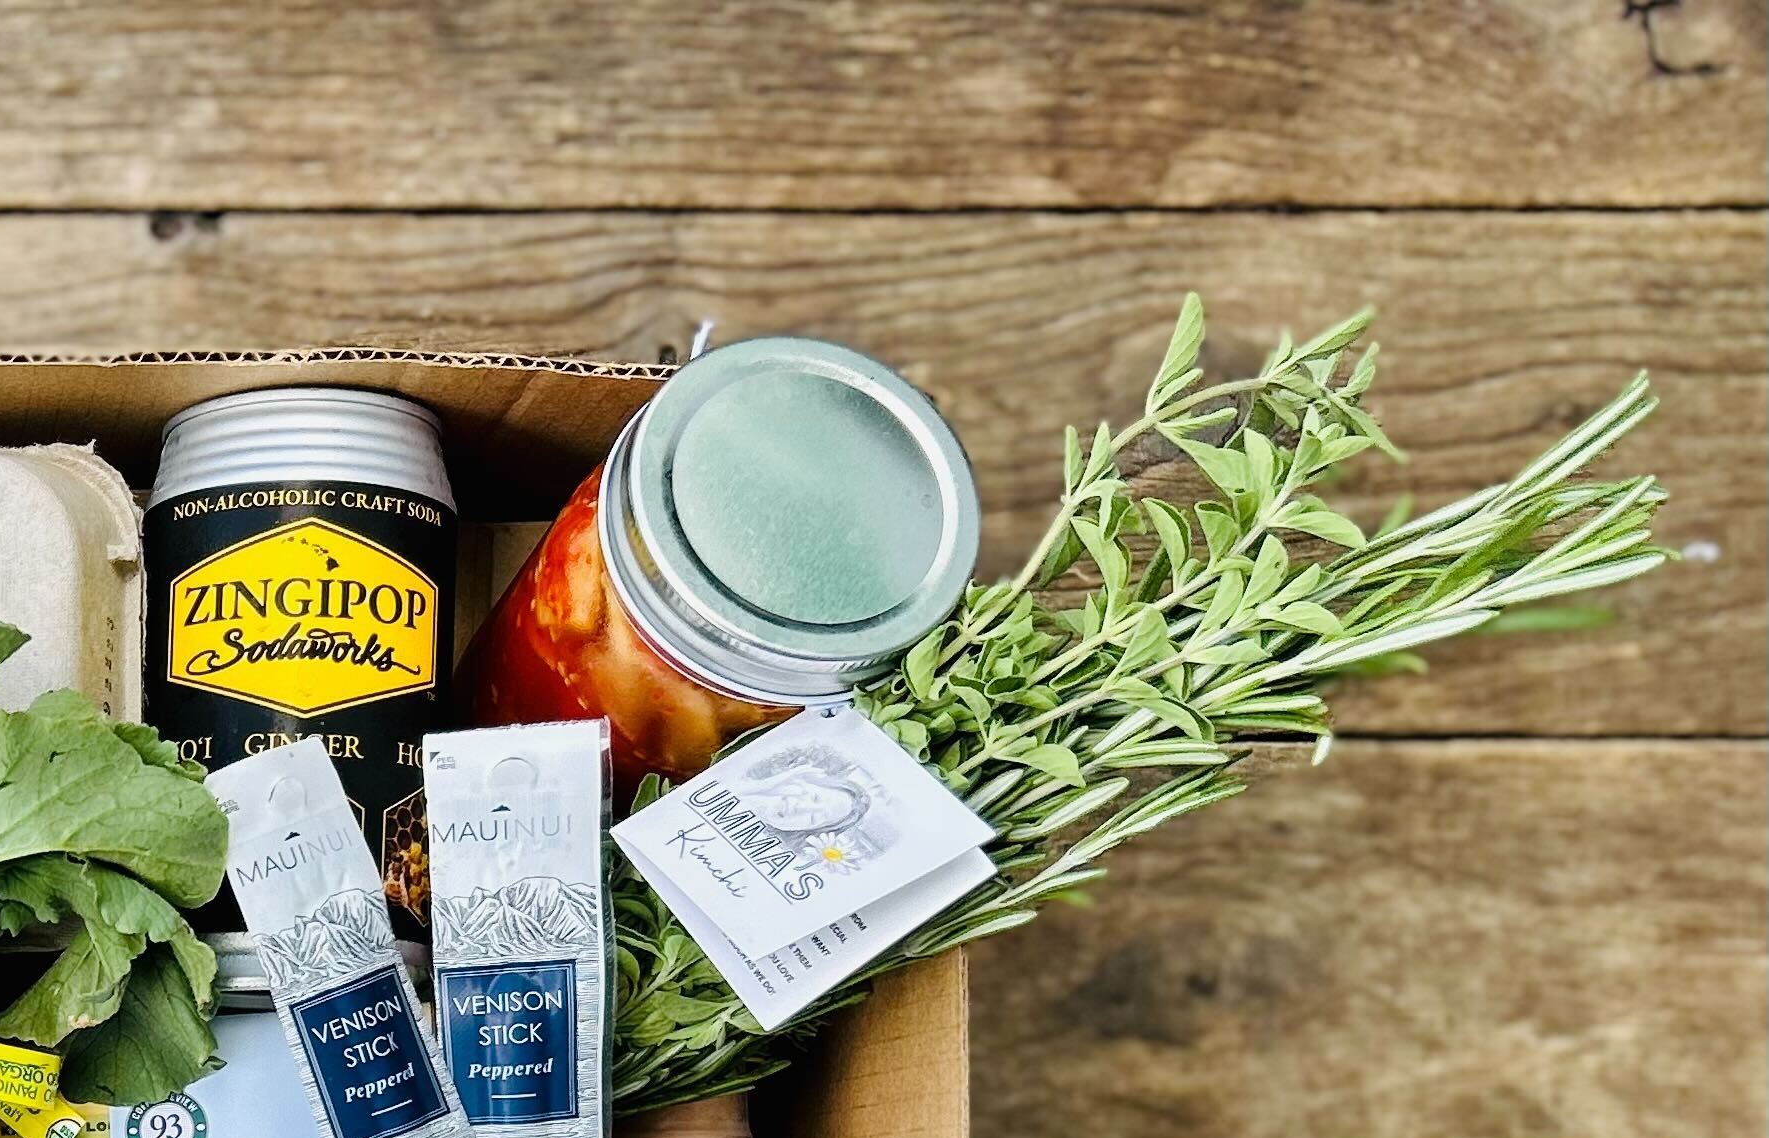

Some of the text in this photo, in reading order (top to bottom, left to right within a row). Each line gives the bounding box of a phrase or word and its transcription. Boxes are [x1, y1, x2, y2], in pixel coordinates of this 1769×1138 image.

[173, 490, 442, 527] NON-ALCOHOLIC CRAFT SODA
[184, 578, 428, 630] ZINGIPOP
[186, 623, 421, 677] Sodaworks
[666, 821, 746, 899] Kimchi
[312, 995, 403, 1044] VENISON
[453, 990, 563, 1016] VENISON
[343, 1031, 400, 1068] STICK
[479, 1022, 543, 1046] STICK
[345, 1063, 415, 1102] Peppered
[468, 1058, 553, 1078] Peppered
